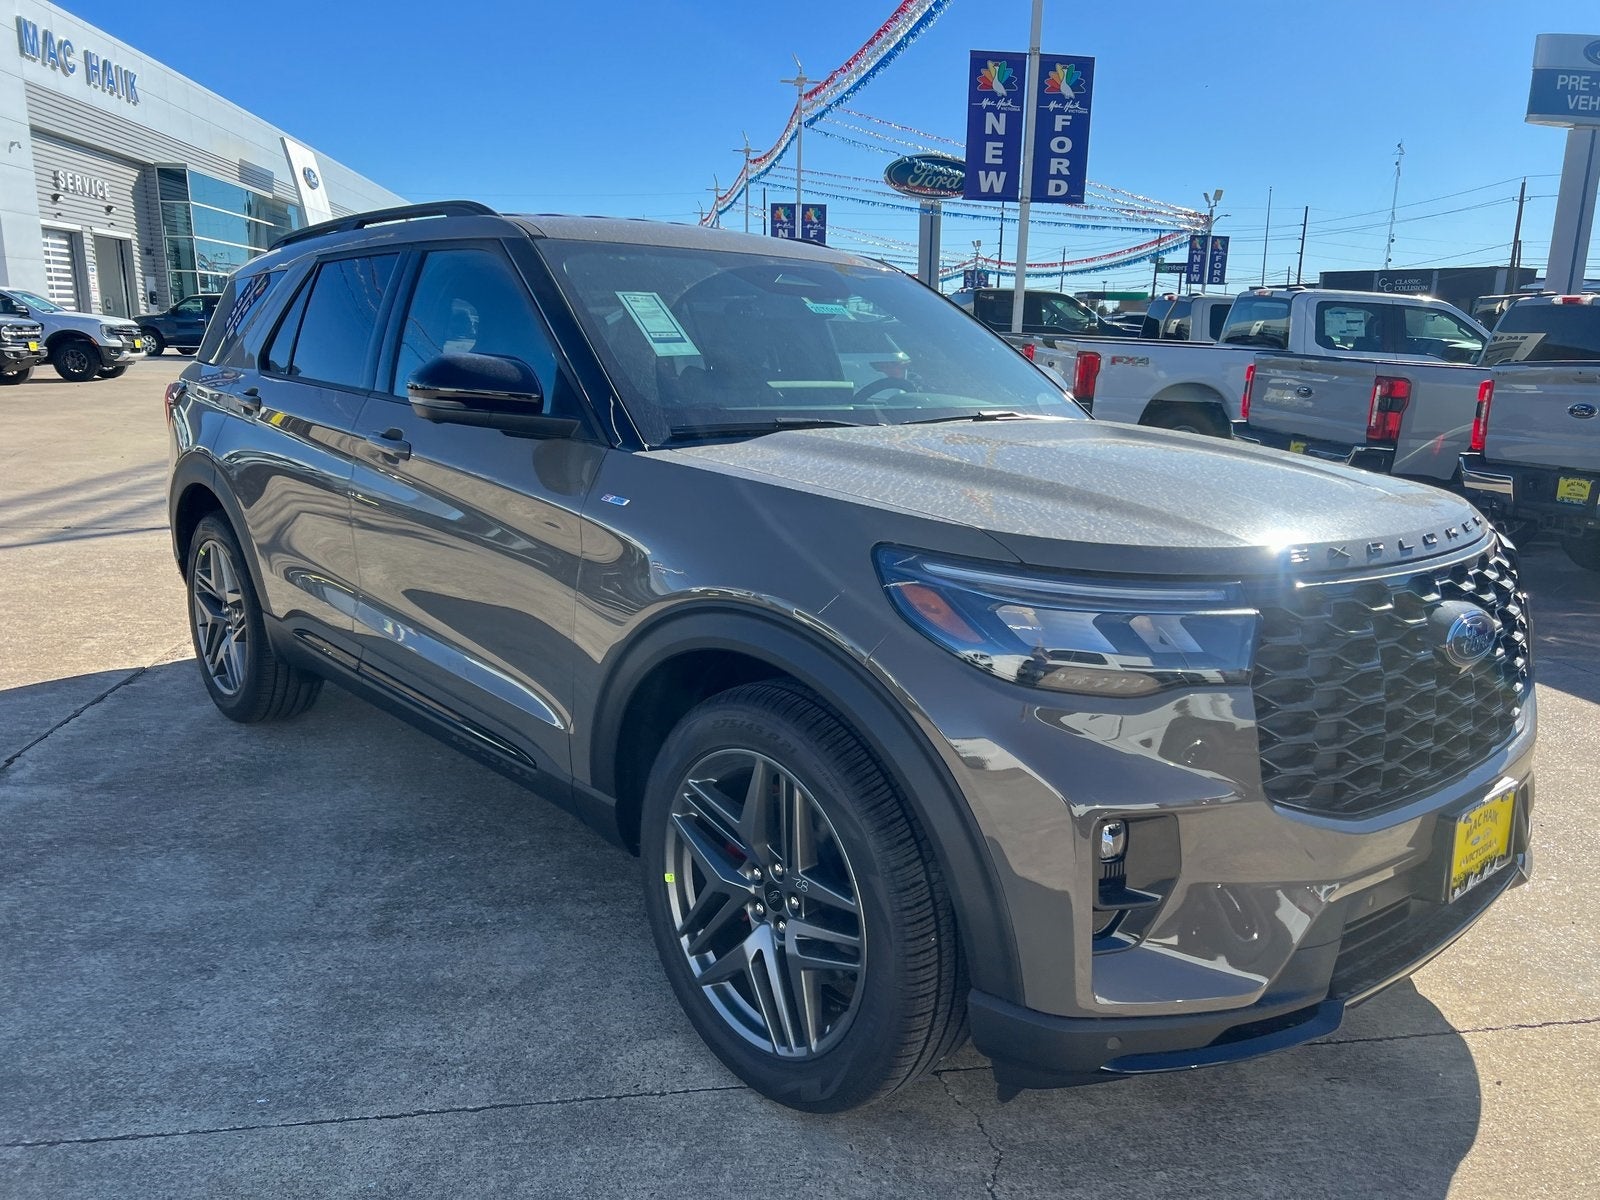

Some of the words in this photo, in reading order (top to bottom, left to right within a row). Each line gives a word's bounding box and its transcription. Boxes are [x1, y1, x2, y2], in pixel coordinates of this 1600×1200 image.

[16, 16, 76, 76] MAC
[84, 50, 139, 105] HAIK
[1557, 75, 1600, 91] PRE-
[979, 112, 1007, 193] NEW
[1047, 115, 1072, 196] FORD
[58, 170, 110, 198] SERVICE
[908, 164, 961, 189] Ford
[1190, 255, 1201, 282] NEW
[1212, 255, 1222, 283] FORD
[1111, 356, 1149, 366] FX4
[1290, 515, 1482, 563] EXPLORER
